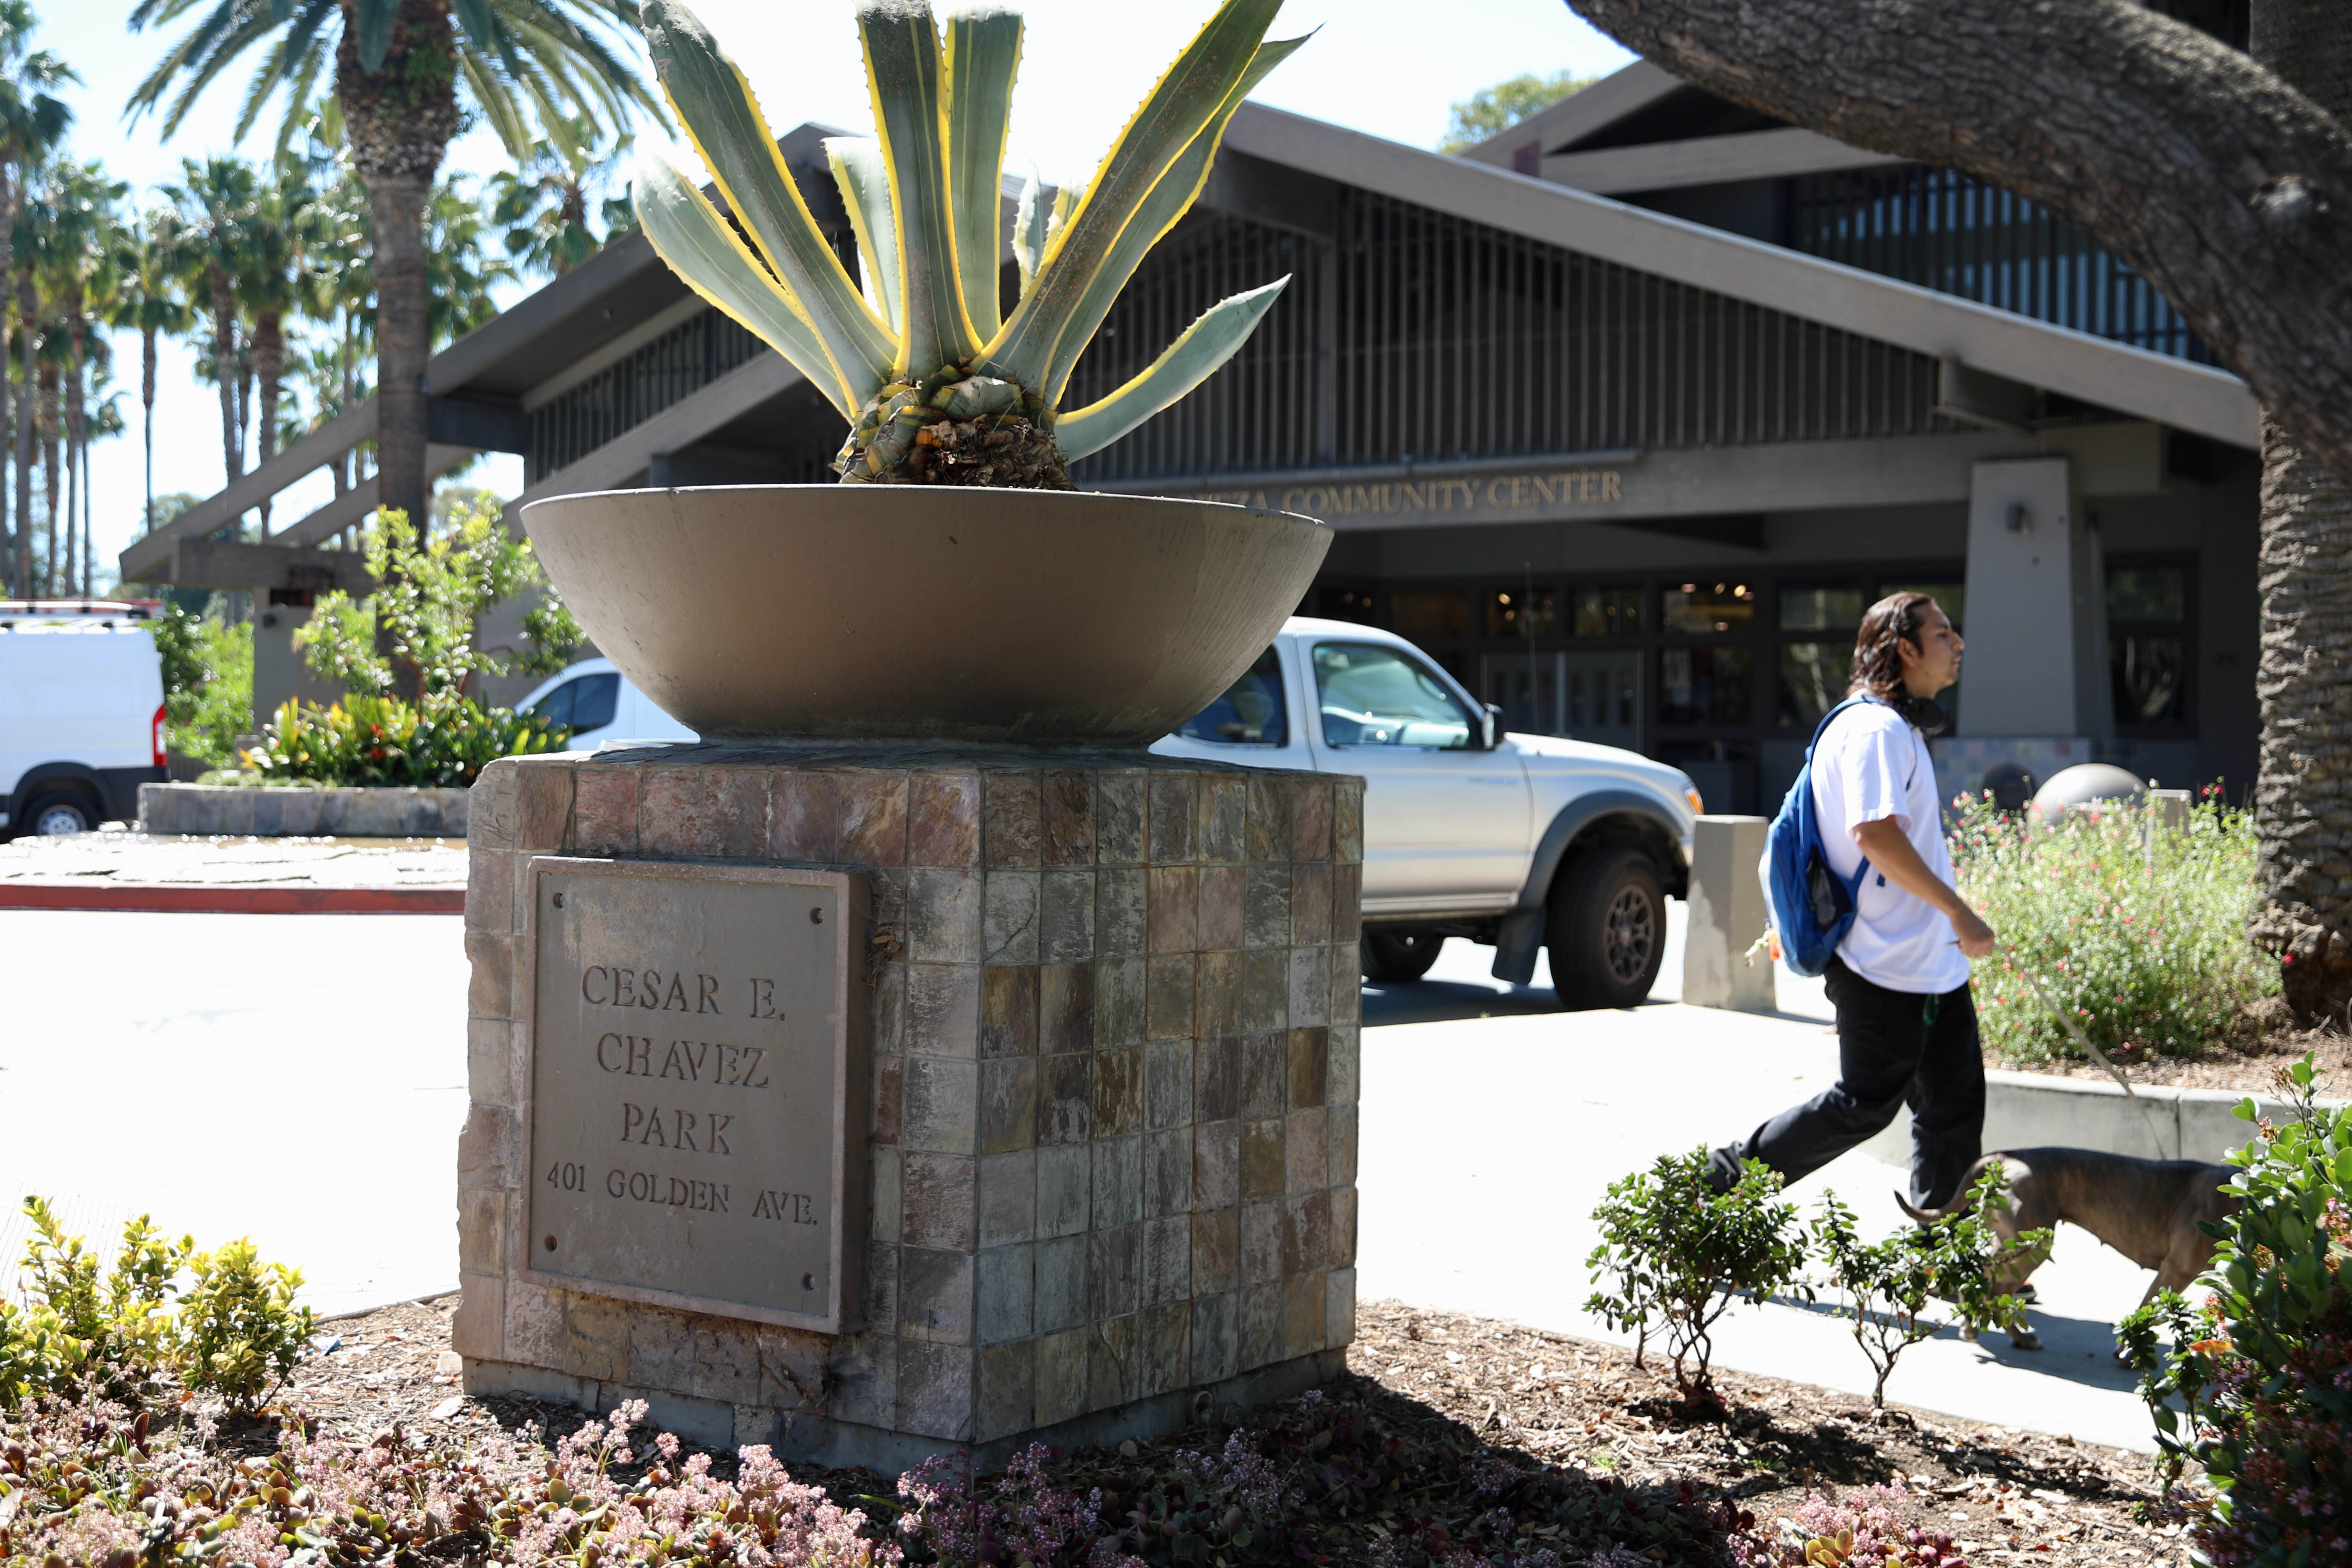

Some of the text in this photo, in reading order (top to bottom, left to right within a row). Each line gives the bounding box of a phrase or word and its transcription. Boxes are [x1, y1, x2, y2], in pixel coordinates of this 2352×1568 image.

[1282, 478, 1481, 515] COMMUNITY
[1487, 470, 1622, 508] CENTER
[582, 965, 786, 1021] CESAR E.
[597, 1032, 769, 1088] CHAVEZ
[621, 1103, 737, 1156] PARK
[547, 1161, 818, 1226] 401 GOLDEN AVE.
